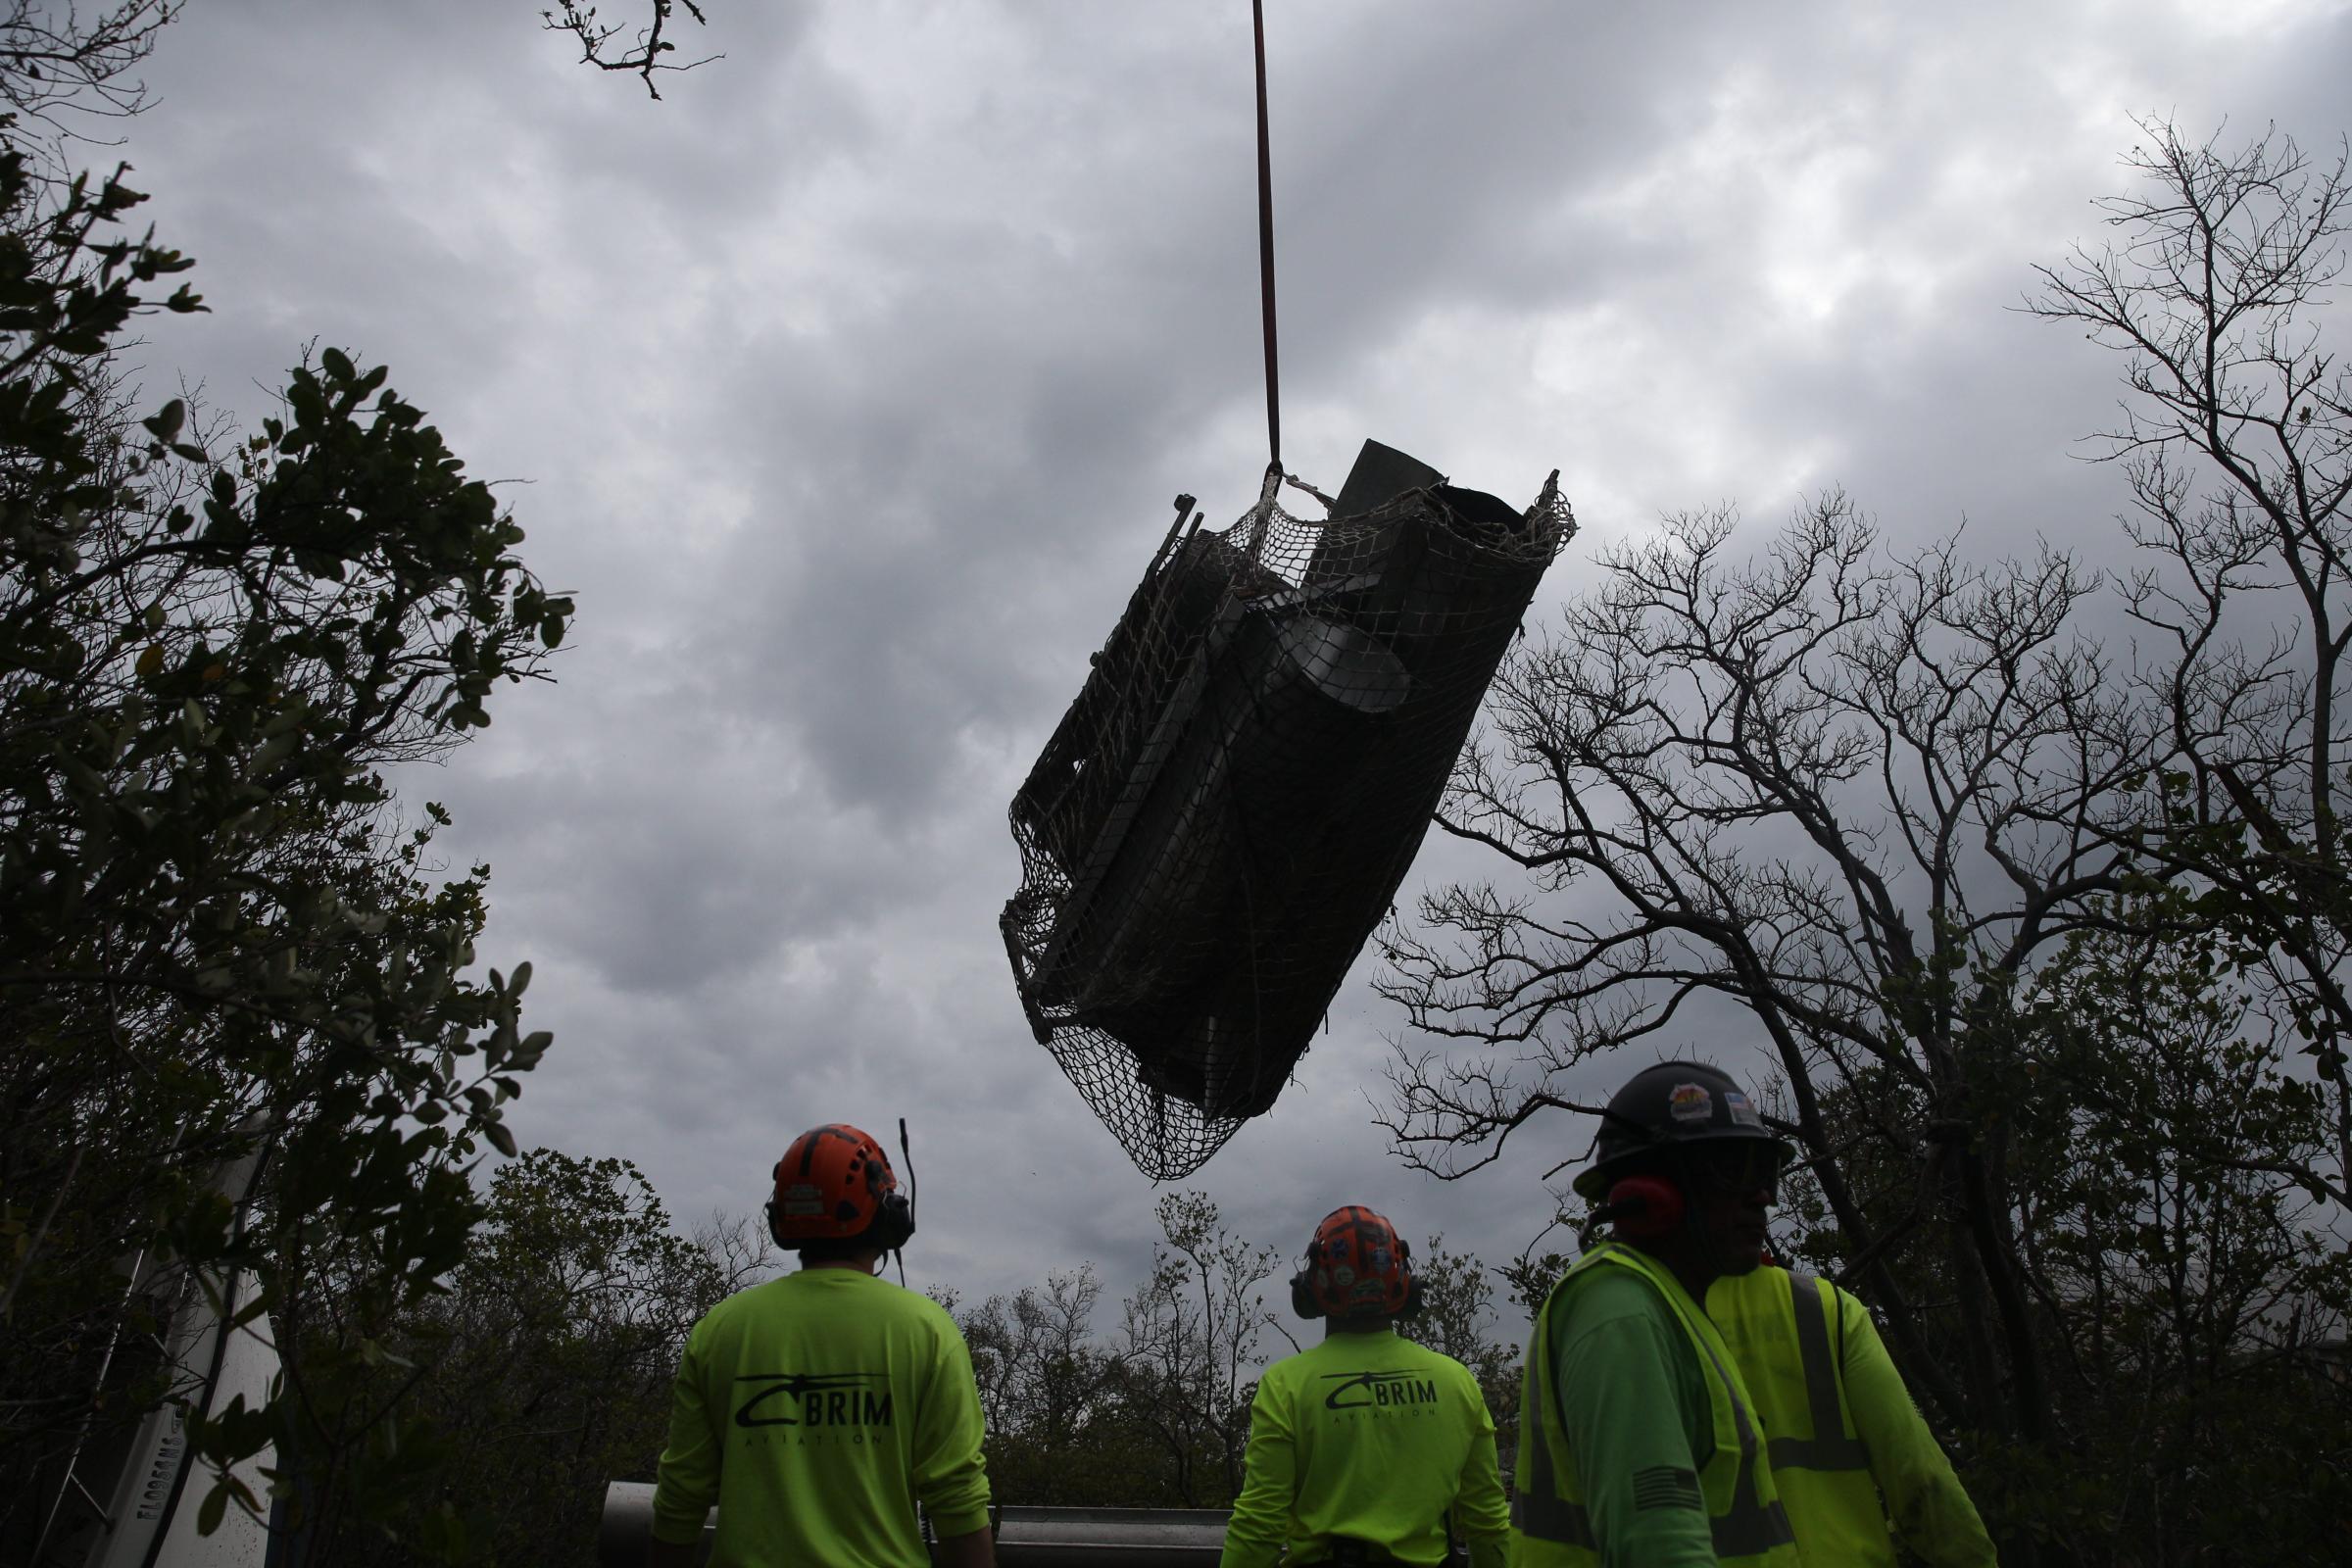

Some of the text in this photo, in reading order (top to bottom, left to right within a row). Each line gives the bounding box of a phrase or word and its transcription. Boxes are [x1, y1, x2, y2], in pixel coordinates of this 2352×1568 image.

[1375, 1379, 1438, 1406] BRIM
[806, 1389, 892, 1427] BRIM
[1334, 1408, 1436, 1426] AVIATION
[745, 1433, 882, 1447] AVIATION
